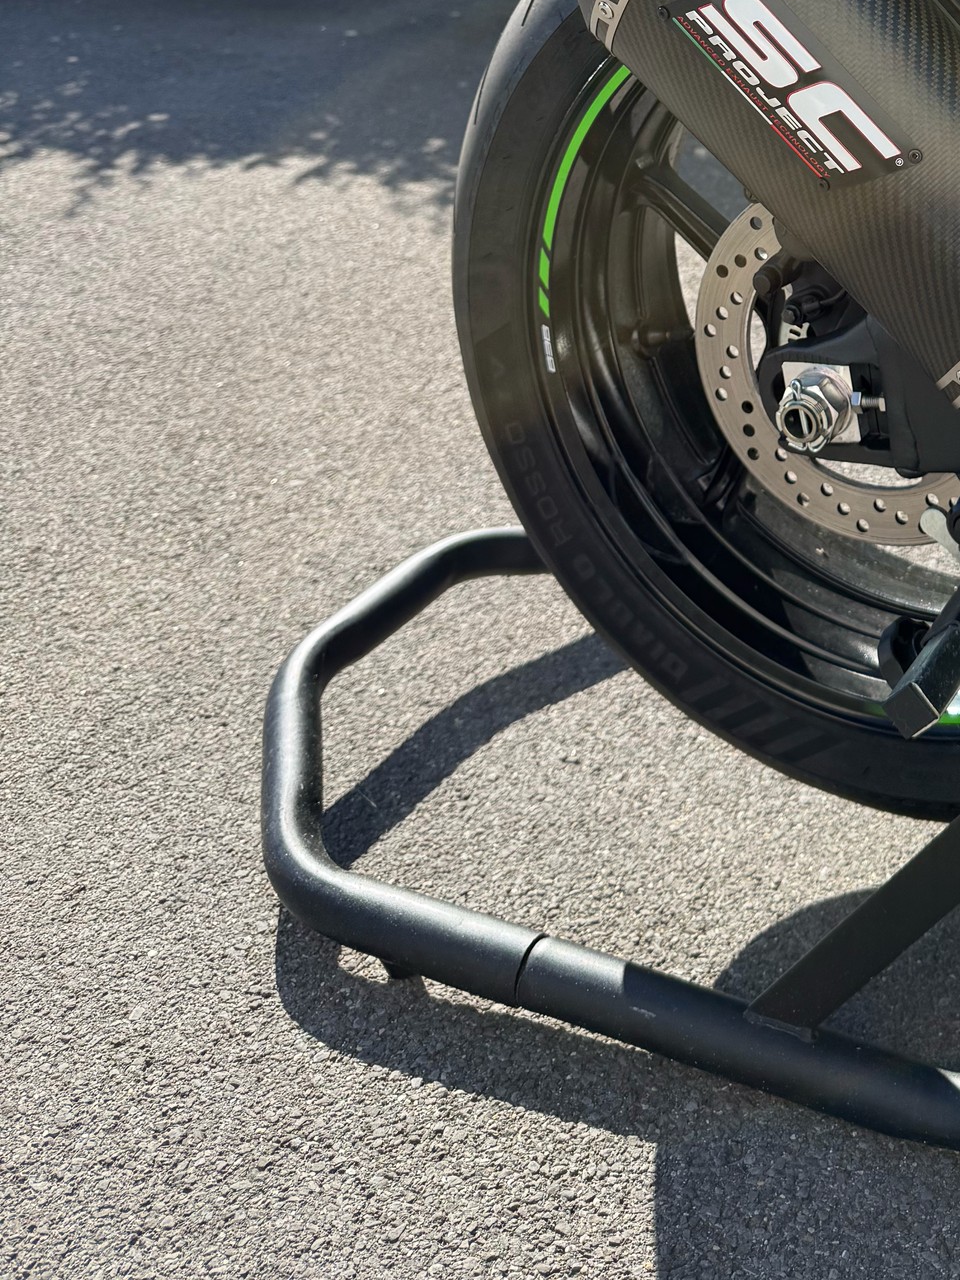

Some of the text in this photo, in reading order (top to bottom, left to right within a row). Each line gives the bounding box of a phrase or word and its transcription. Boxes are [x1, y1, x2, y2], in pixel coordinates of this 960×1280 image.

[677, 15, 831, 178] ADVANCED EXHAUST TECHNOLOGY
[685, 10, 845, 174] PROJECT
[504, 419, 689, 684] DIABLO ROSSO
